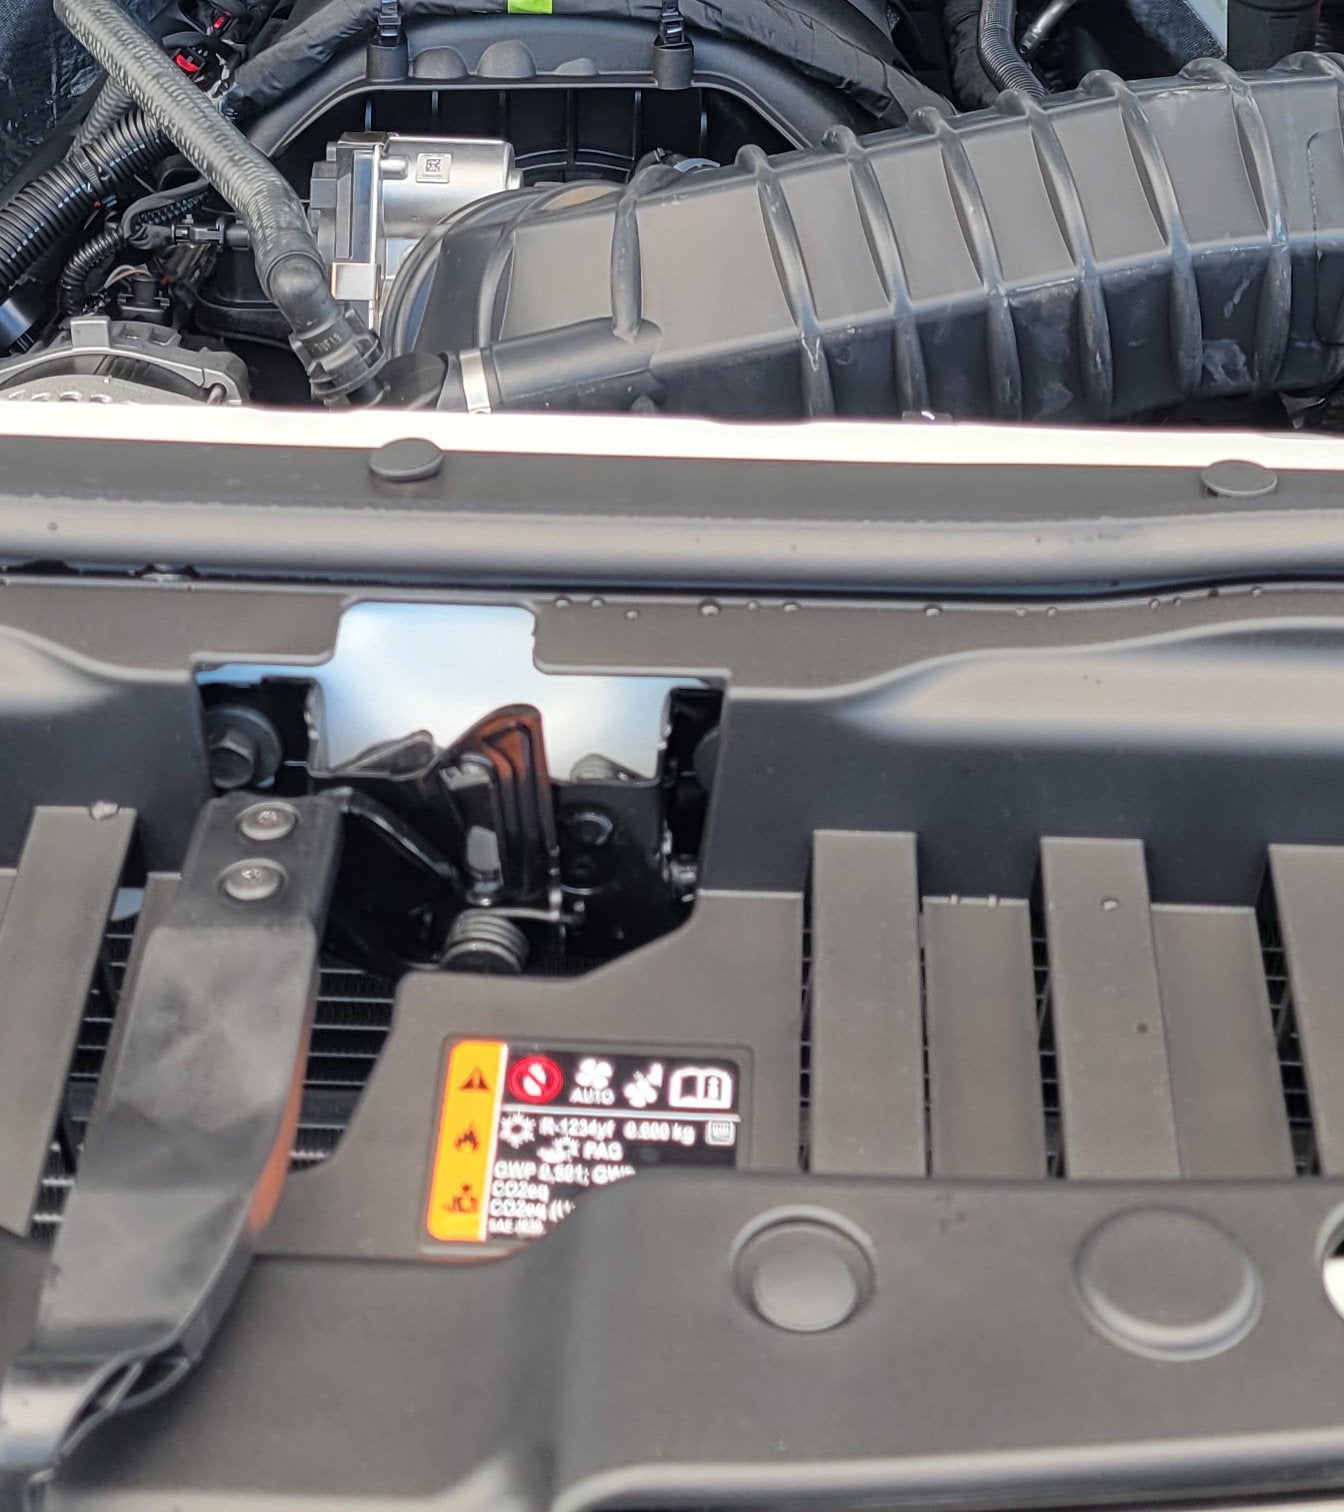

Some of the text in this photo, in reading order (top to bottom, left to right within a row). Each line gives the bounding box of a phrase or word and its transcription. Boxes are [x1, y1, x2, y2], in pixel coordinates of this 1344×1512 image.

[569, 1088, 615, 1105] AUTO
[671, 1121, 696, 1146] kg
[582, 1140, 623, 1161] PAG
[494, 1160, 536, 1180] GWP
